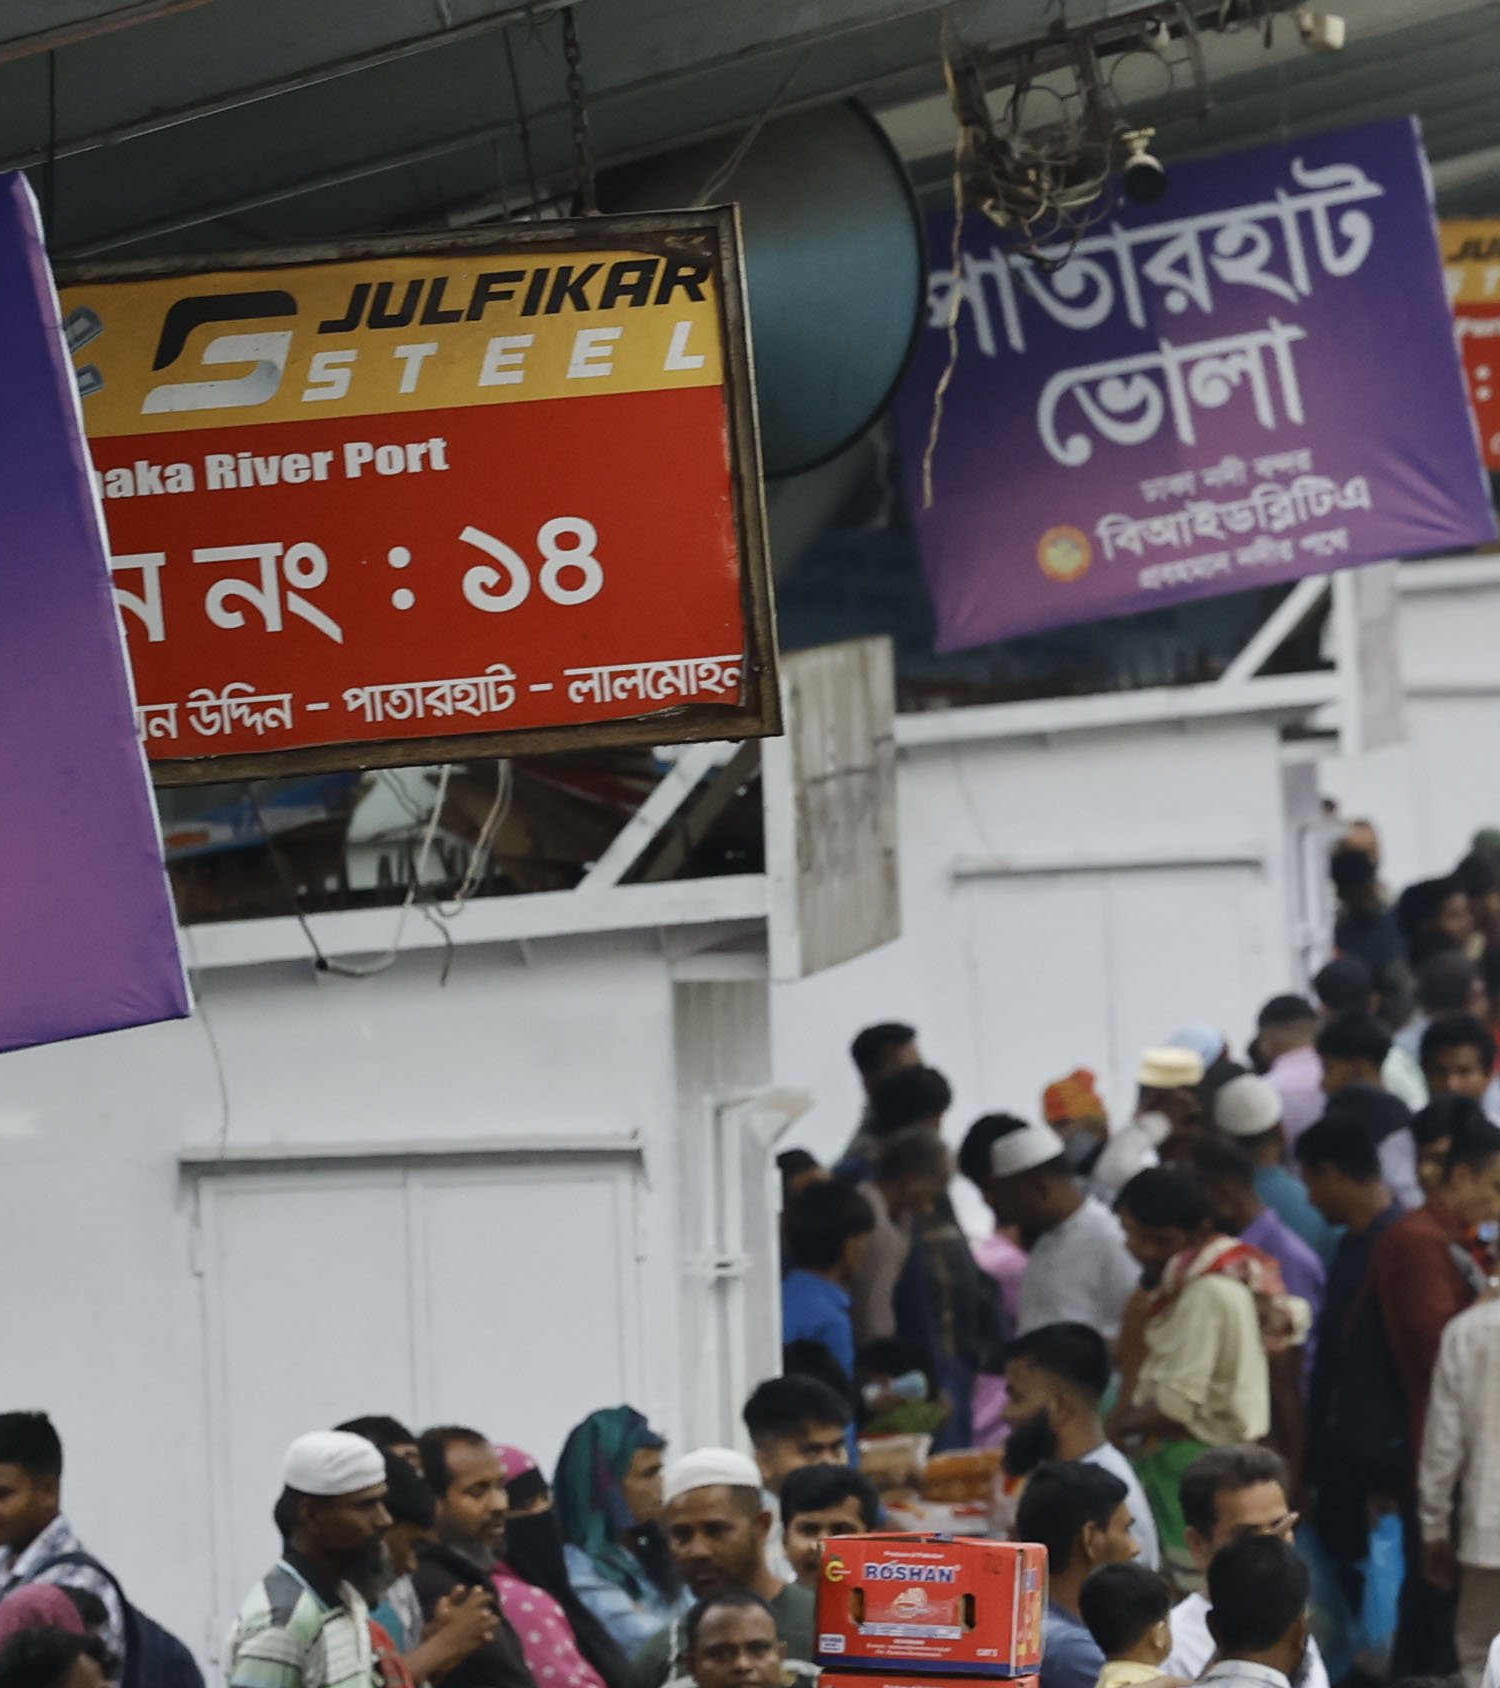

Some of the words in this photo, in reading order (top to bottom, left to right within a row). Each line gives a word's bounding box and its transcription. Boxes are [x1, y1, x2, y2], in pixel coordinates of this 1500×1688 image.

[318, 258, 713, 335] JULFIKAR
[302, 321, 706, 402] STEEL
[1037, 318, 1306, 467] ভোলা
[204, 451, 334, 491] River
[344, 437, 450, 479] Port
[111, 551, 167, 643] ন
[192, 541, 344, 645] নং
[458, 514, 604, 614] ১৪
[135, 702, 179, 742] ান
[186, 682, 294, 737] উদ্দিন
[341, 662, 517, 724] পাতারহাট
